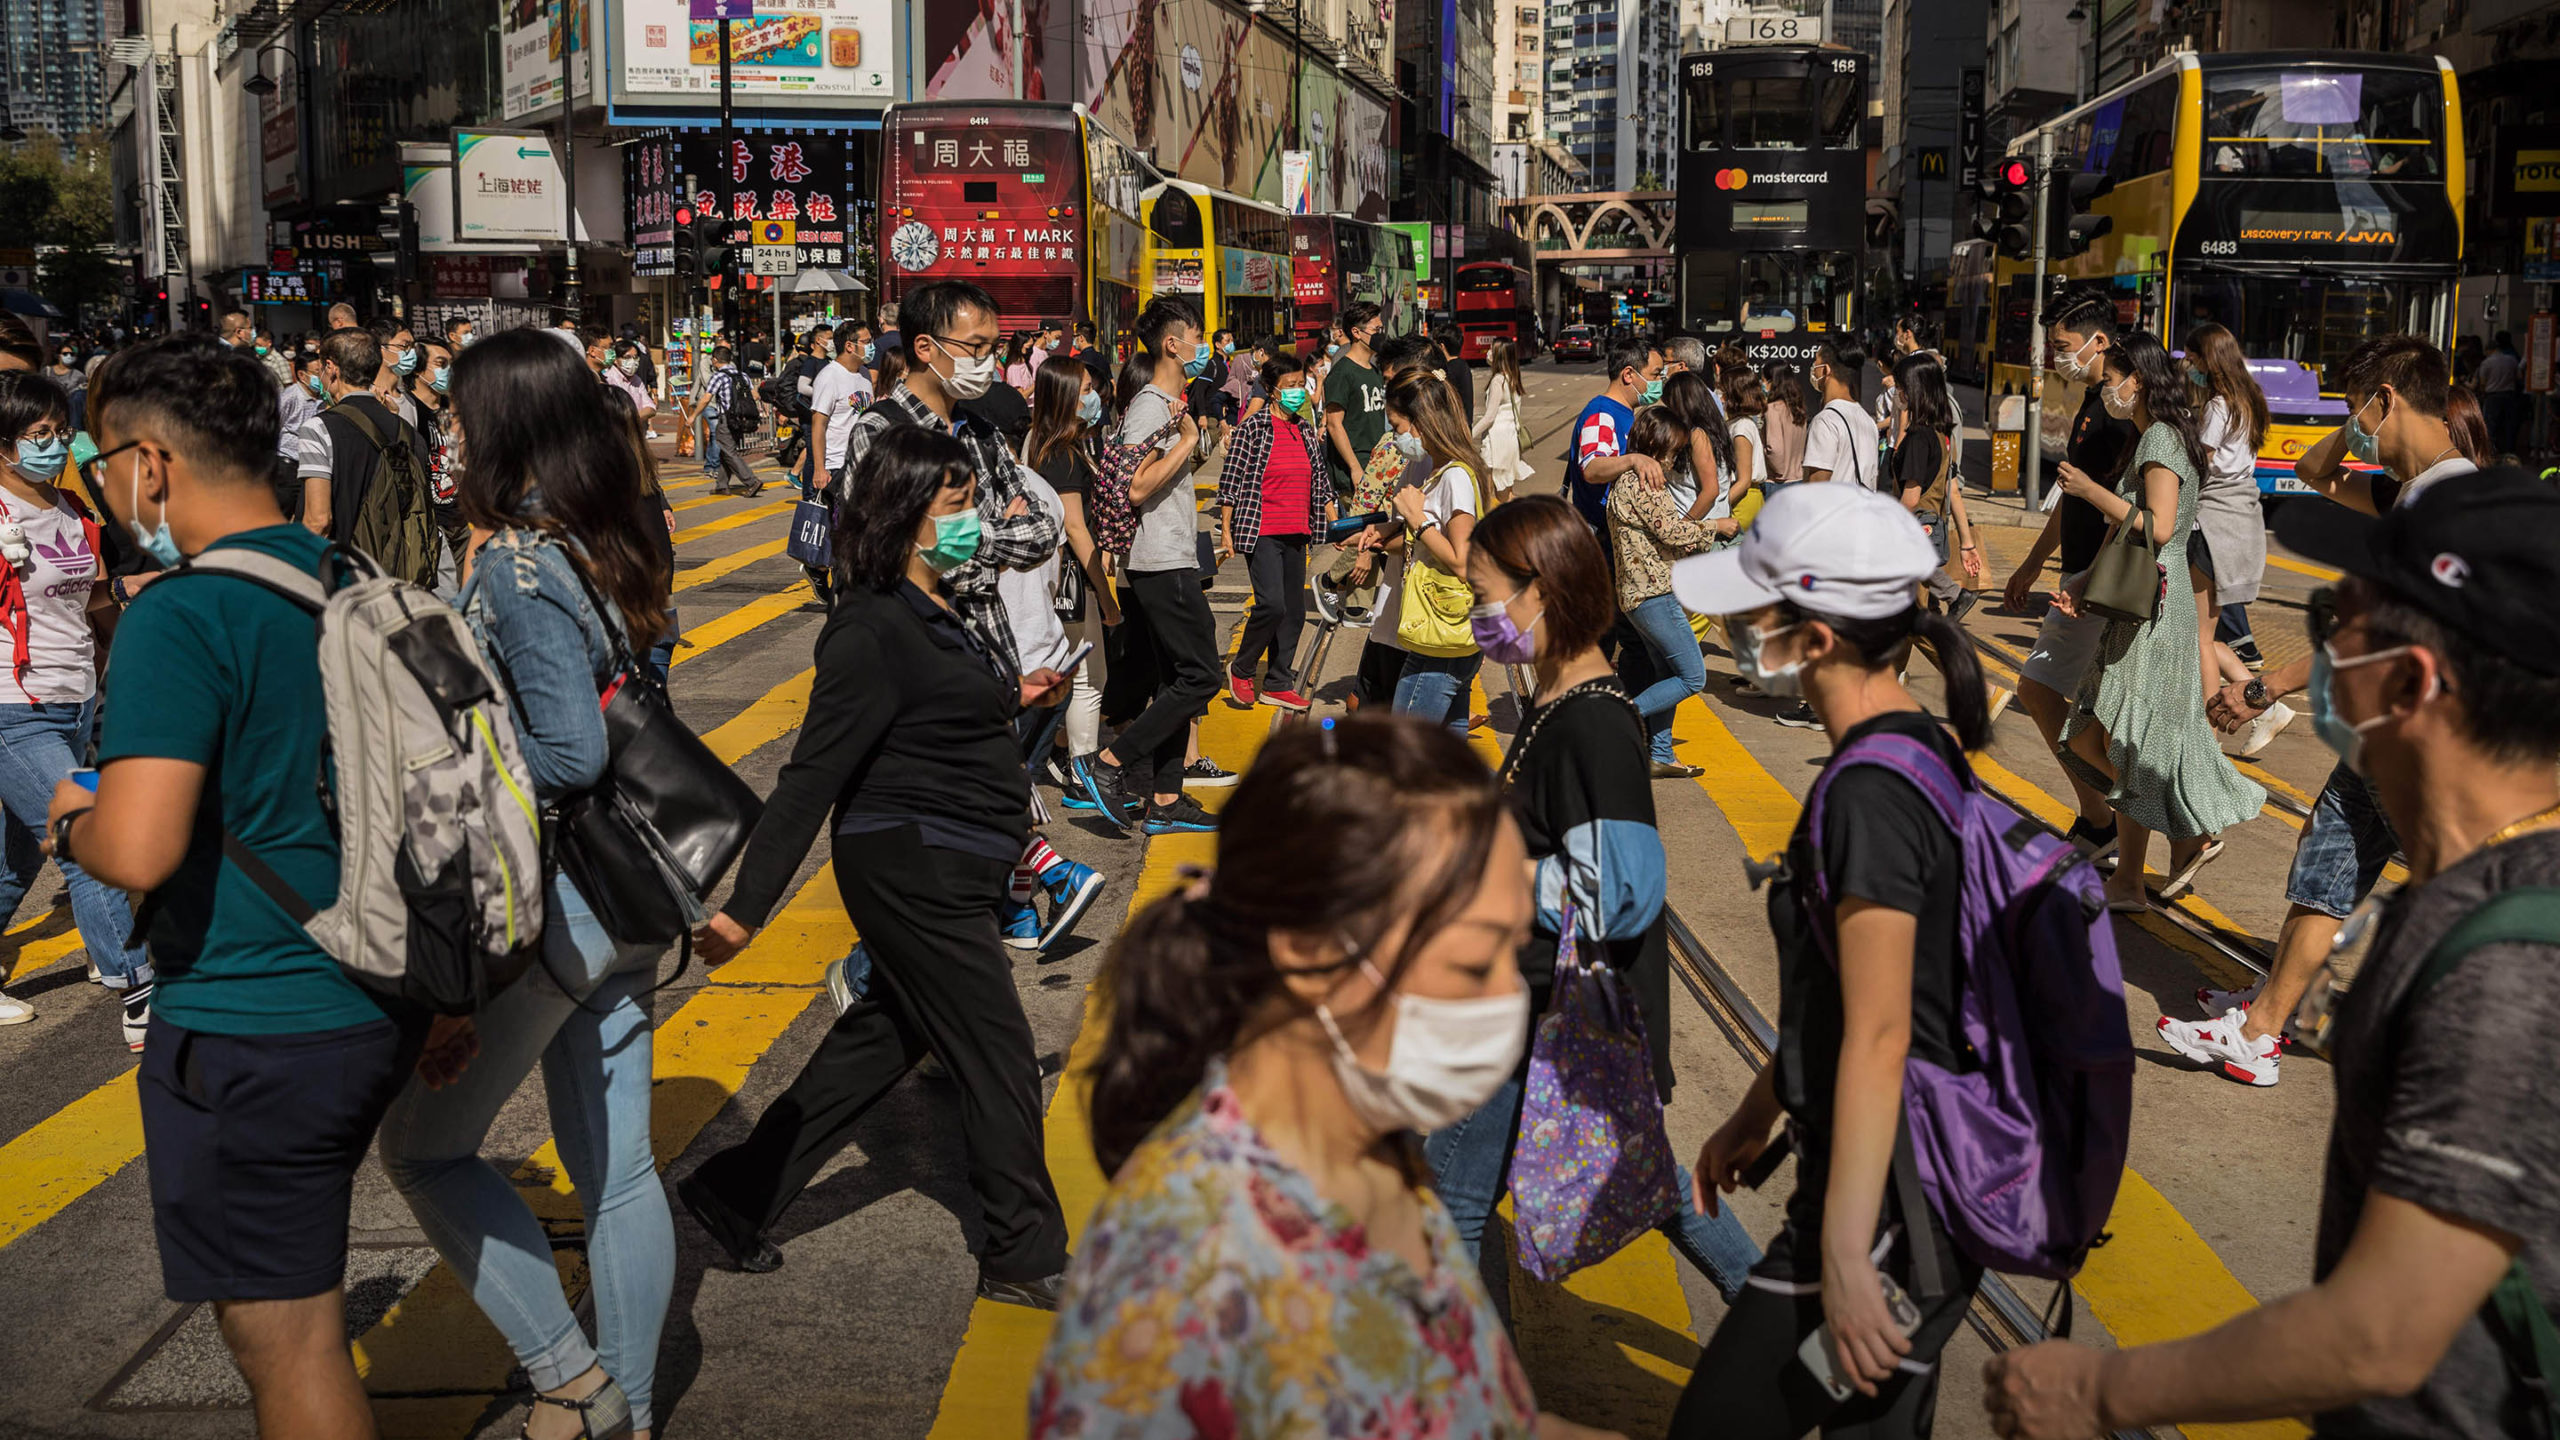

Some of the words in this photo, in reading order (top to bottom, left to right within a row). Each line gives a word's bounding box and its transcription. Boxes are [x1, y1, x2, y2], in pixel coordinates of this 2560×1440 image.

[1751, 19, 1798, 39] 168
[1690, 63, 1713, 76] 168
[1832, 59, 1855, 73] 168
[970, 117, 989, 125] 6414
[934, 139, 1030, 168] 周大福
[1753, 171, 1827, 183] mastercard
[478, 176, 543, 194] 上海姥姥
[304, 234, 361, 249] LUSH
[944, 228, 995, 243] 周大福
[1006, 229, 1016, 242] T
[1024, 229, 1074, 242] MARK
[758, 248, 772, 257] 24
[775, 248, 791, 257] hrs
[2201, 241, 2237, 255] 6483
[762, 260, 788, 272] 全日
[1745, 345, 1798, 359] K$200
[1801, 345, 1821, 359] of
[800, 520, 826, 547] GAP
[44, 577, 94, 598] adidas
